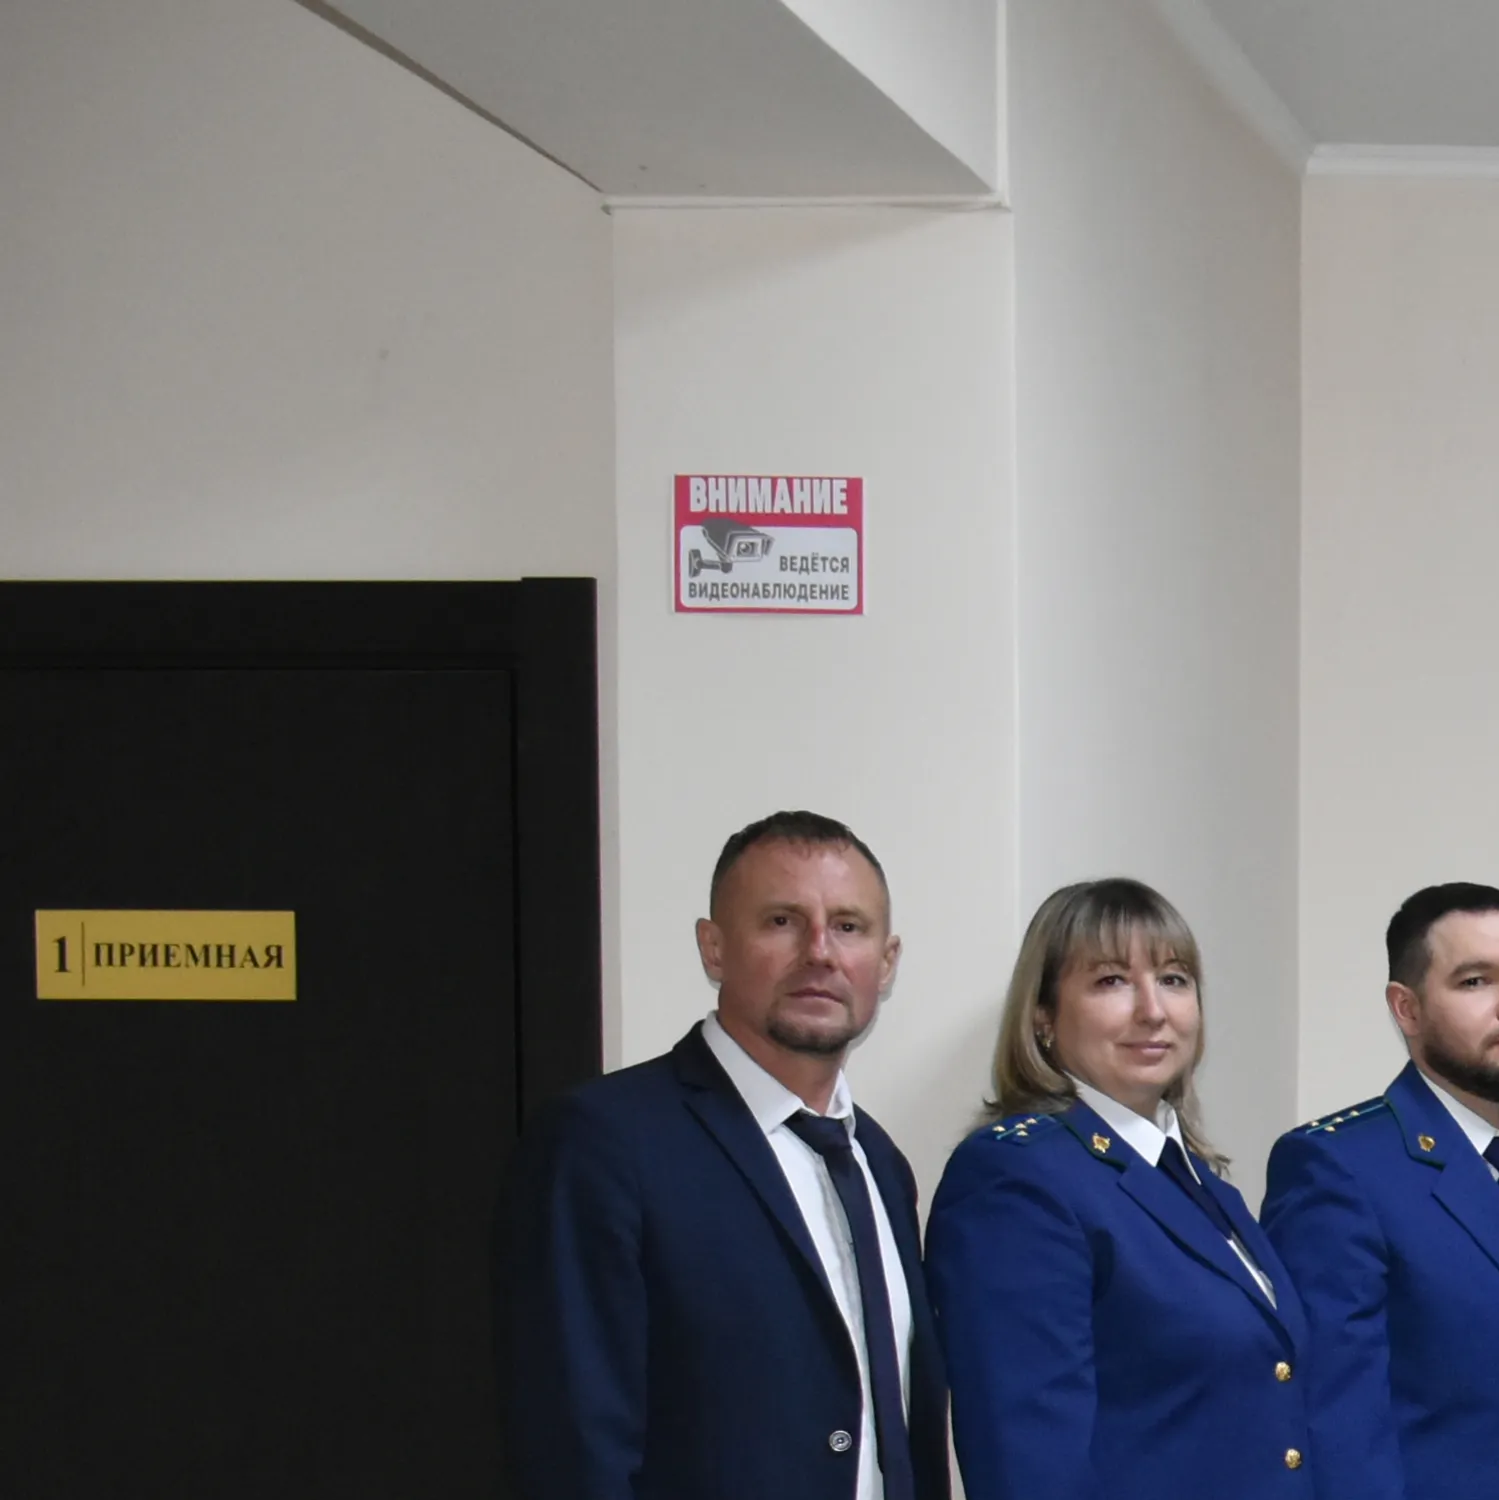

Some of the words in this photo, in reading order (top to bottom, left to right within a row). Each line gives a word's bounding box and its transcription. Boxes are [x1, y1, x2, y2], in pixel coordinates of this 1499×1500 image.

[689, 476, 848, 514] ВНИМАНИЕ
[779, 552, 850, 575] ВЕДЁТСЯ
[688, 582, 850, 602] ВИДЕОНАБЛЮДЕНИЕ
[53, 935, 71, 973] 1
[93, 942, 285, 969] ПРИЕМНАЯ
